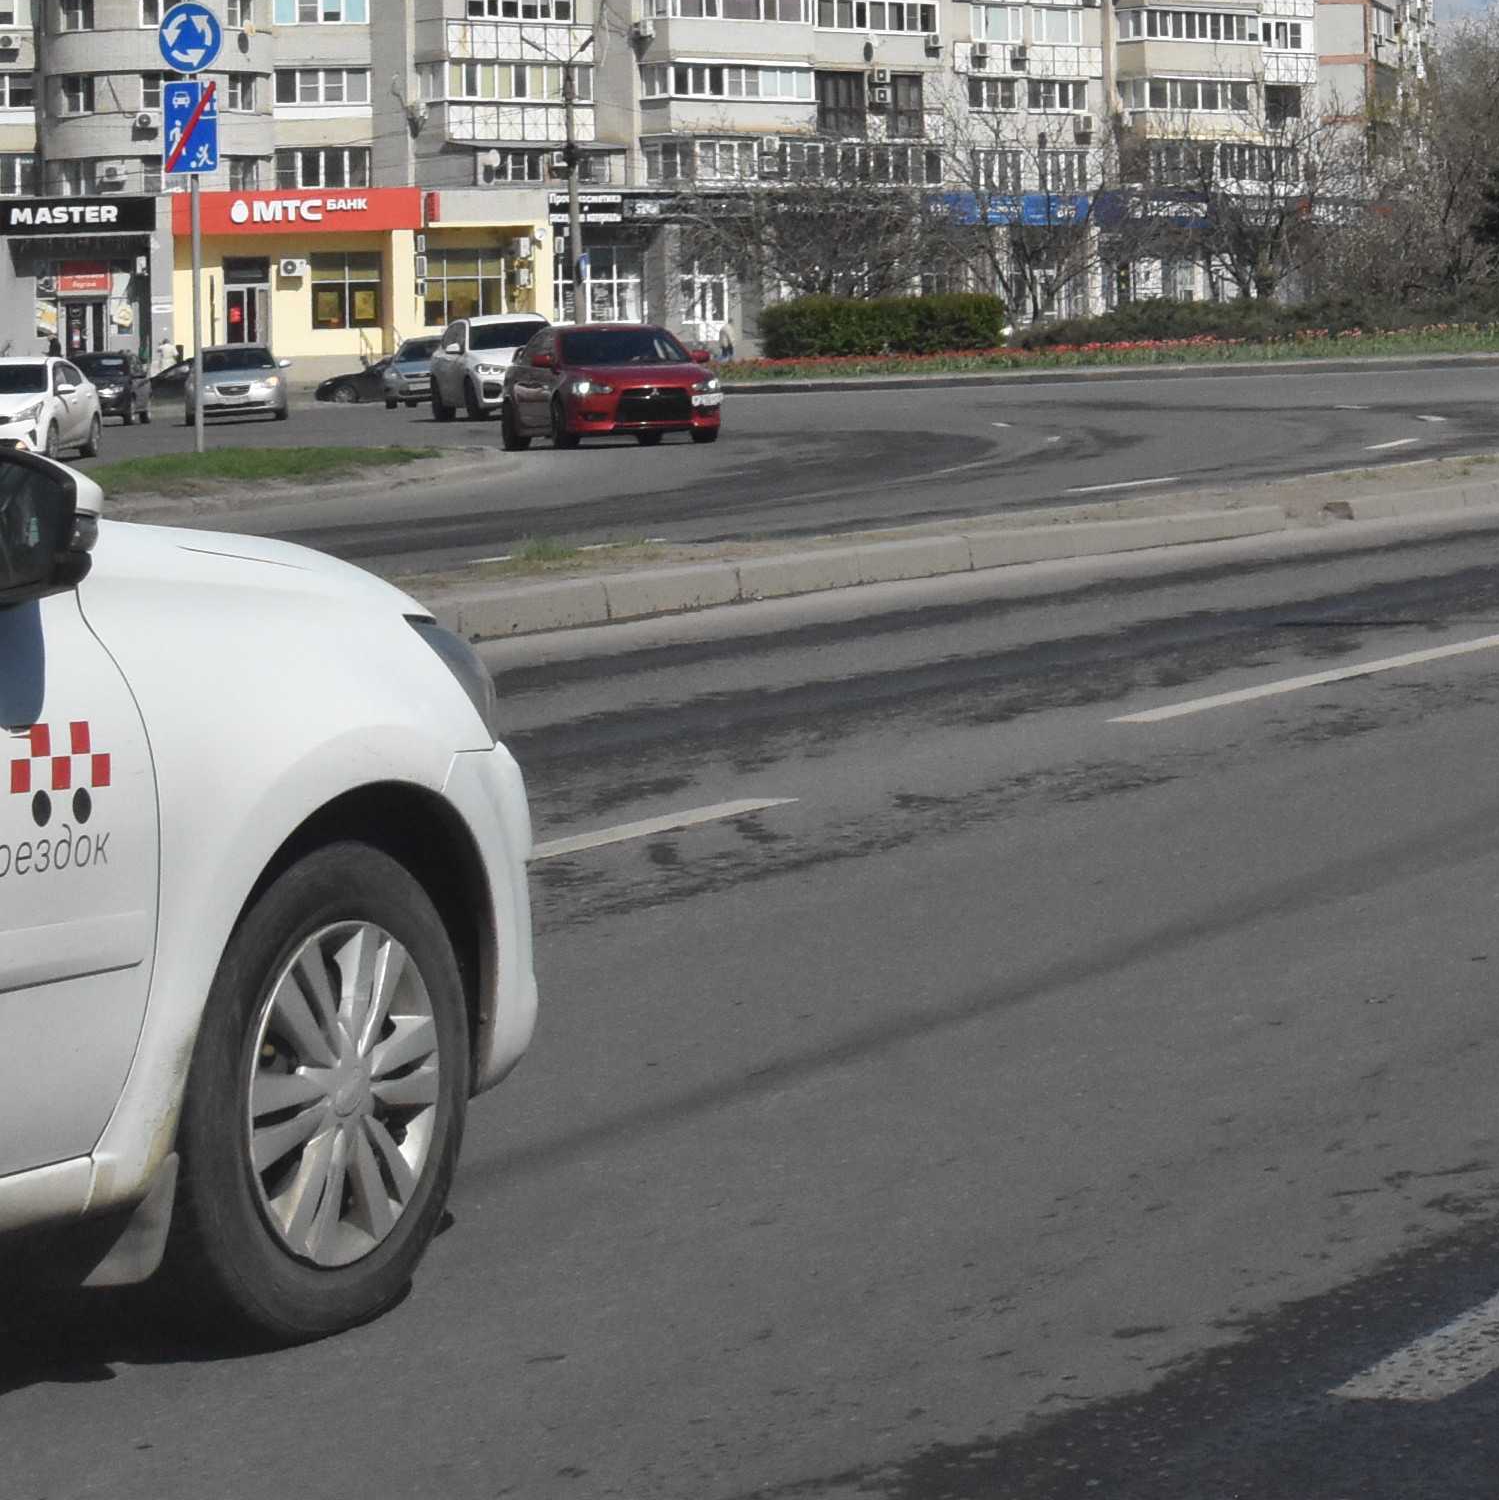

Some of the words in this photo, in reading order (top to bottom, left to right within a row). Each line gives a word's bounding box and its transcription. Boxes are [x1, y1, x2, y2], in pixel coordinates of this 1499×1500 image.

[10, 205, 119, 225] MASTER
[252, 199, 323, 222] МТС
[326, 198, 368, 211] БАНК
